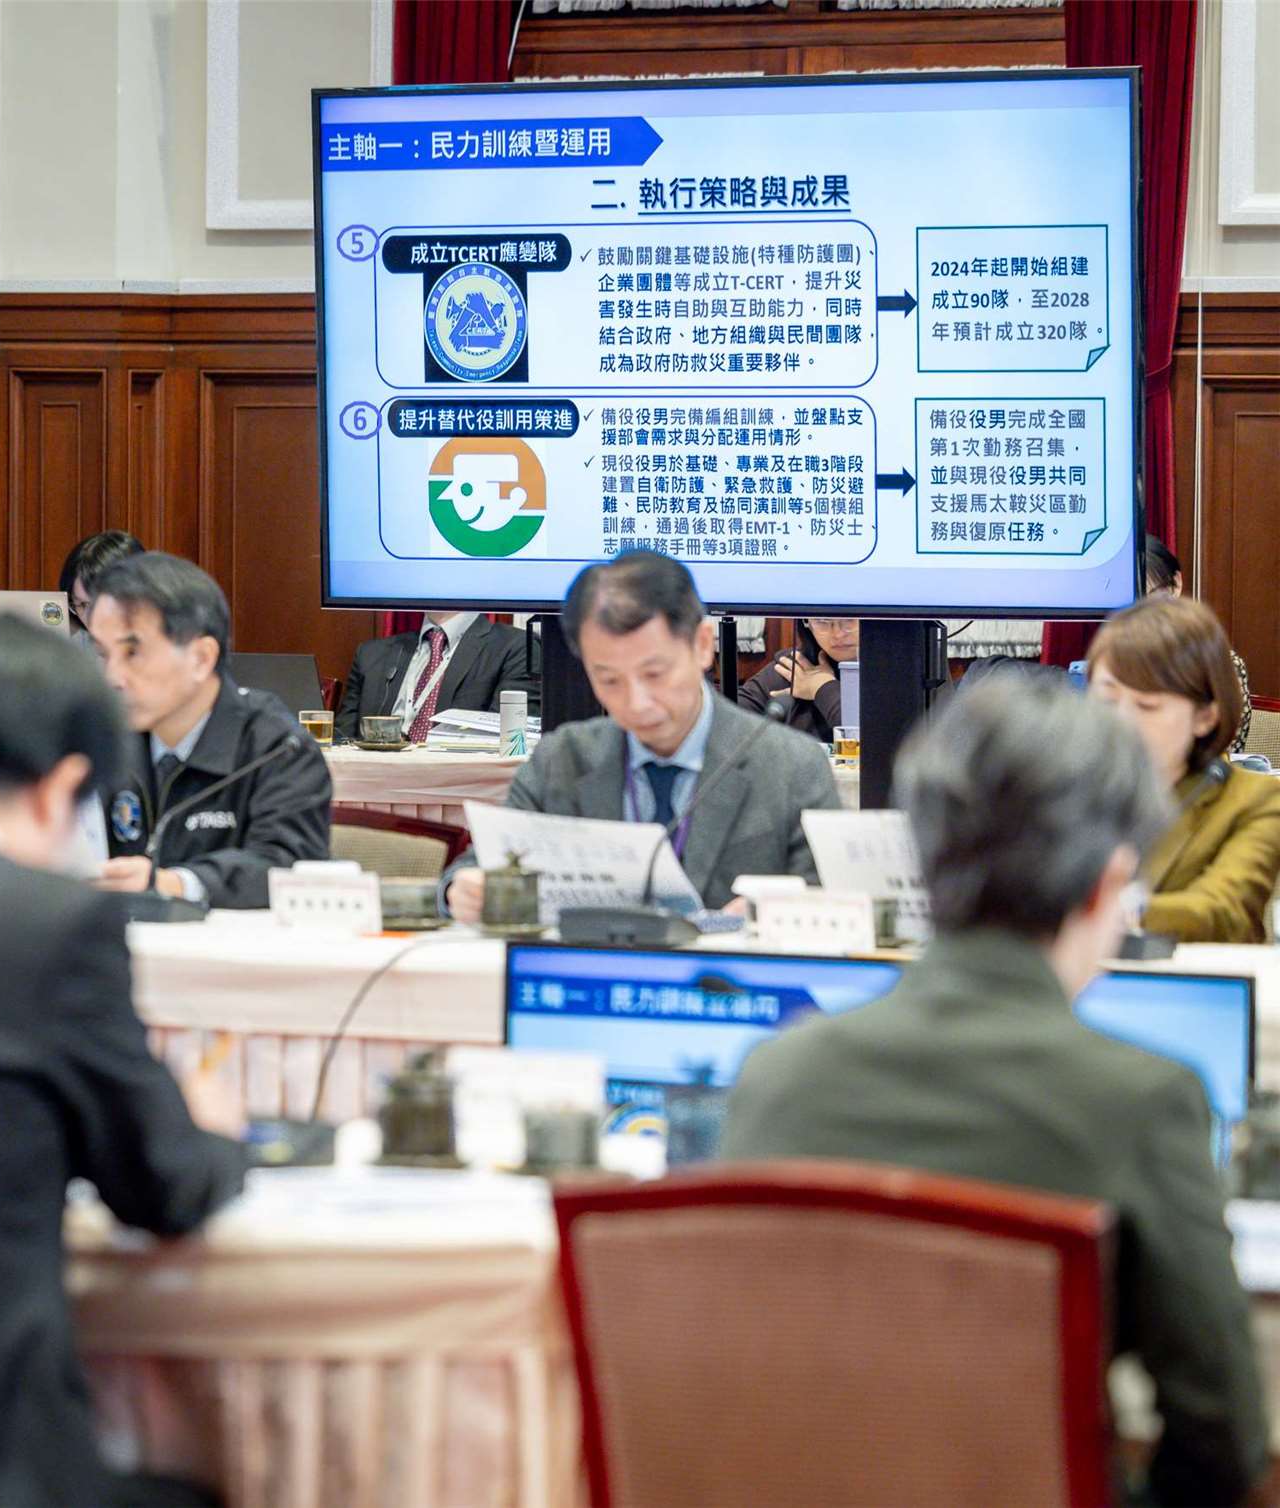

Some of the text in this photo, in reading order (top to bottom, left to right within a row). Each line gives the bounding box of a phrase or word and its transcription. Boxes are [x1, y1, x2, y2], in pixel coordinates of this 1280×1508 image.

[329, 128, 611, 161] 主軸一：民力訓練暨運用
[411, 240, 557, 263] 成立TCERT應變隊
[931, 256, 1089, 277] 2024年起開始組建
[932, 321, 1102, 341] 年預計成立320隊。
[600, 353, 814, 372] 成為政府防救災重要夥伴。
[399, 408, 573, 432] 提升替代役訓用策進
[930, 409, 1086, 429] 備役役男完成全國
[602, 428, 812, 446] 援部會需求與分配運用情形。
[602, 455, 863, 473] 現役役男於基礎、專業及在職3階段
[930, 465, 1086, 486] 並與現役役男共同
[602, 497, 863, 515] 難、民防教育及協同演訓等5個模組
[931, 493, 1086, 514] 支援馬太鞍災區勤
[931, 522, 1058, 542] 務與復原任務。
